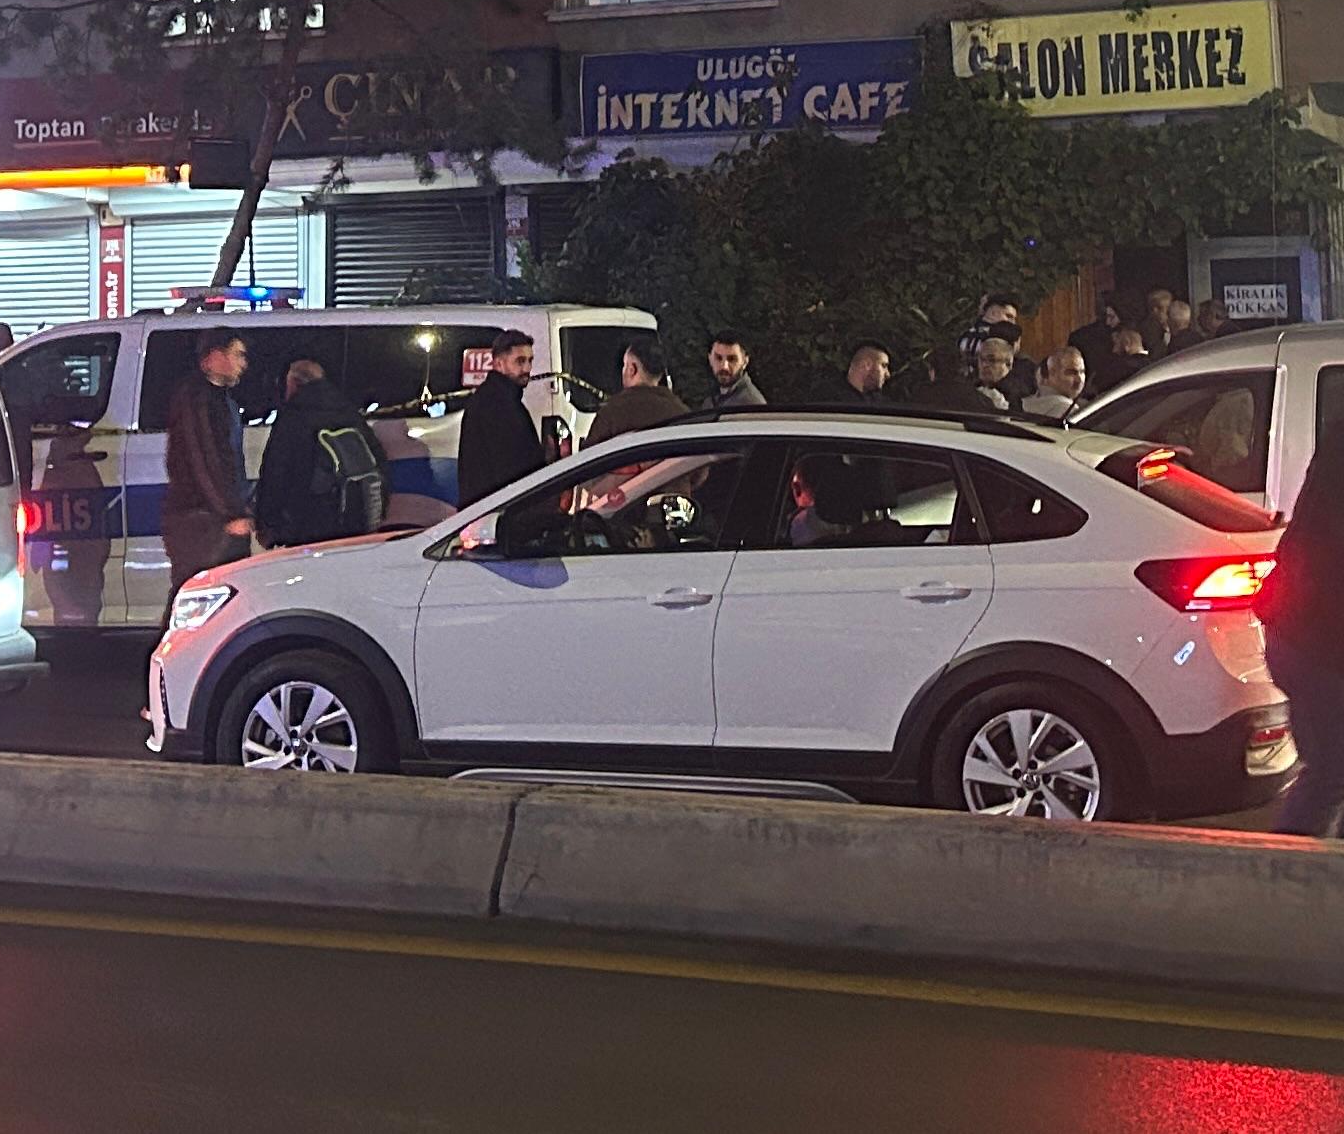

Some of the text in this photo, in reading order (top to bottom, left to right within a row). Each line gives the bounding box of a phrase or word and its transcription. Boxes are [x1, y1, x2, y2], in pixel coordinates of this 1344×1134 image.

[1099, 27, 1246, 95] MERKEZ
[803, 80, 909, 123] CAFE
[14, 118, 84, 142] Toptan
[1226, 286, 1285, 300] KİRALIK
[1226, 301, 1286, 315] DÜKKAN
[468, 352, 494, 371] 112
[22, 493, 92, 534] OLİS
